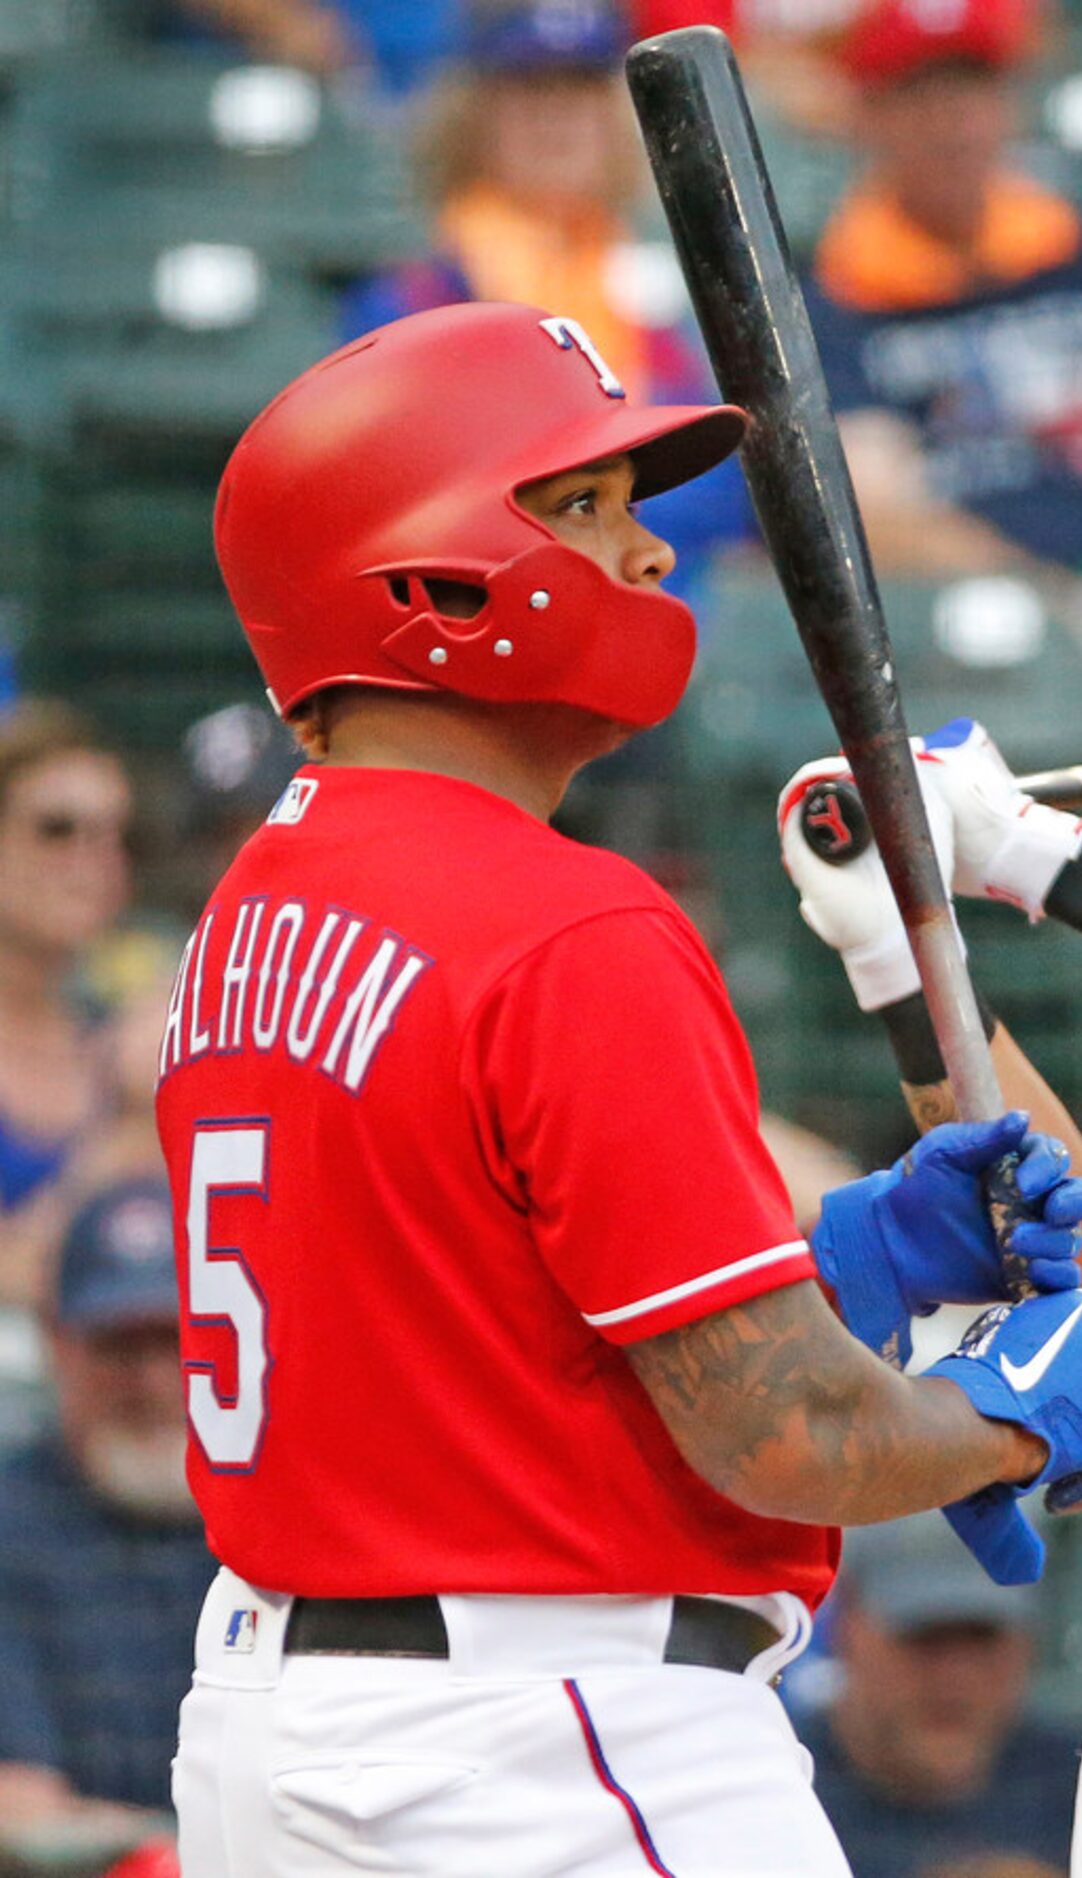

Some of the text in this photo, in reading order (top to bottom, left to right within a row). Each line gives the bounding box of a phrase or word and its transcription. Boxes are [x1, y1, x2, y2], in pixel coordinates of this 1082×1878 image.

[538, 316, 626, 400] T
[155, 895, 435, 1098] ALHOUN
[184, 1116, 276, 1474] 5
